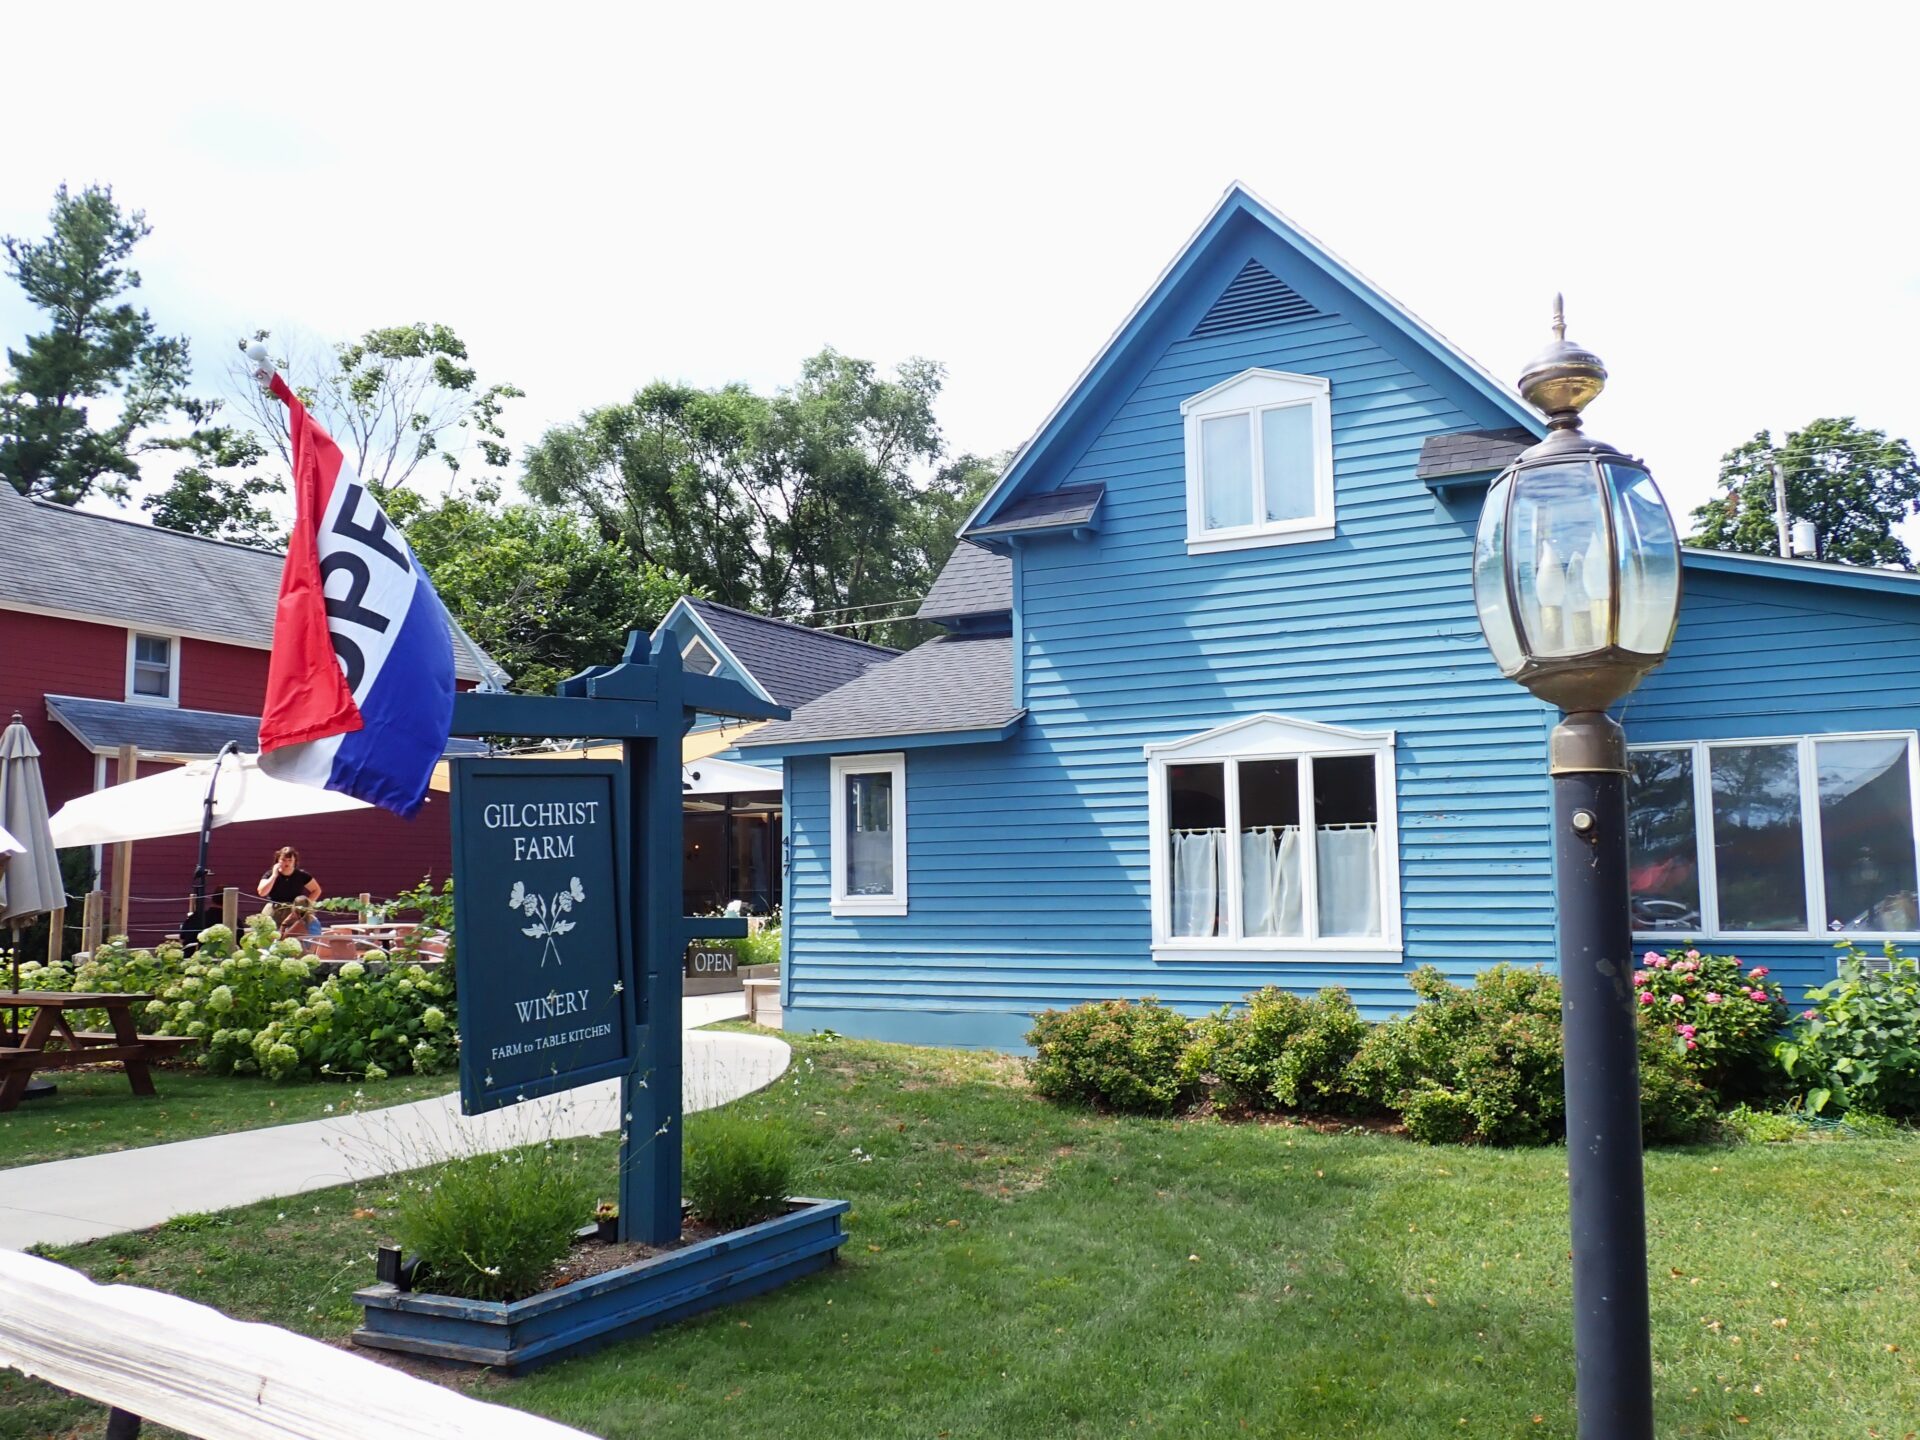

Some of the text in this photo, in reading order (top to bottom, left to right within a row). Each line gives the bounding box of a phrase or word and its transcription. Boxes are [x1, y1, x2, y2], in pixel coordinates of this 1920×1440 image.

[484, 801, 599, 829] GILCHRIST
[513, 835, 576, 861] FARM
[782, 835, 791, 878] 417
[694, 952, 733, 972] OPEN
[514, 990, 589, 1024] WINERY
[491, 1023, 612, 1060] FARM to TABLE KITCHEN
